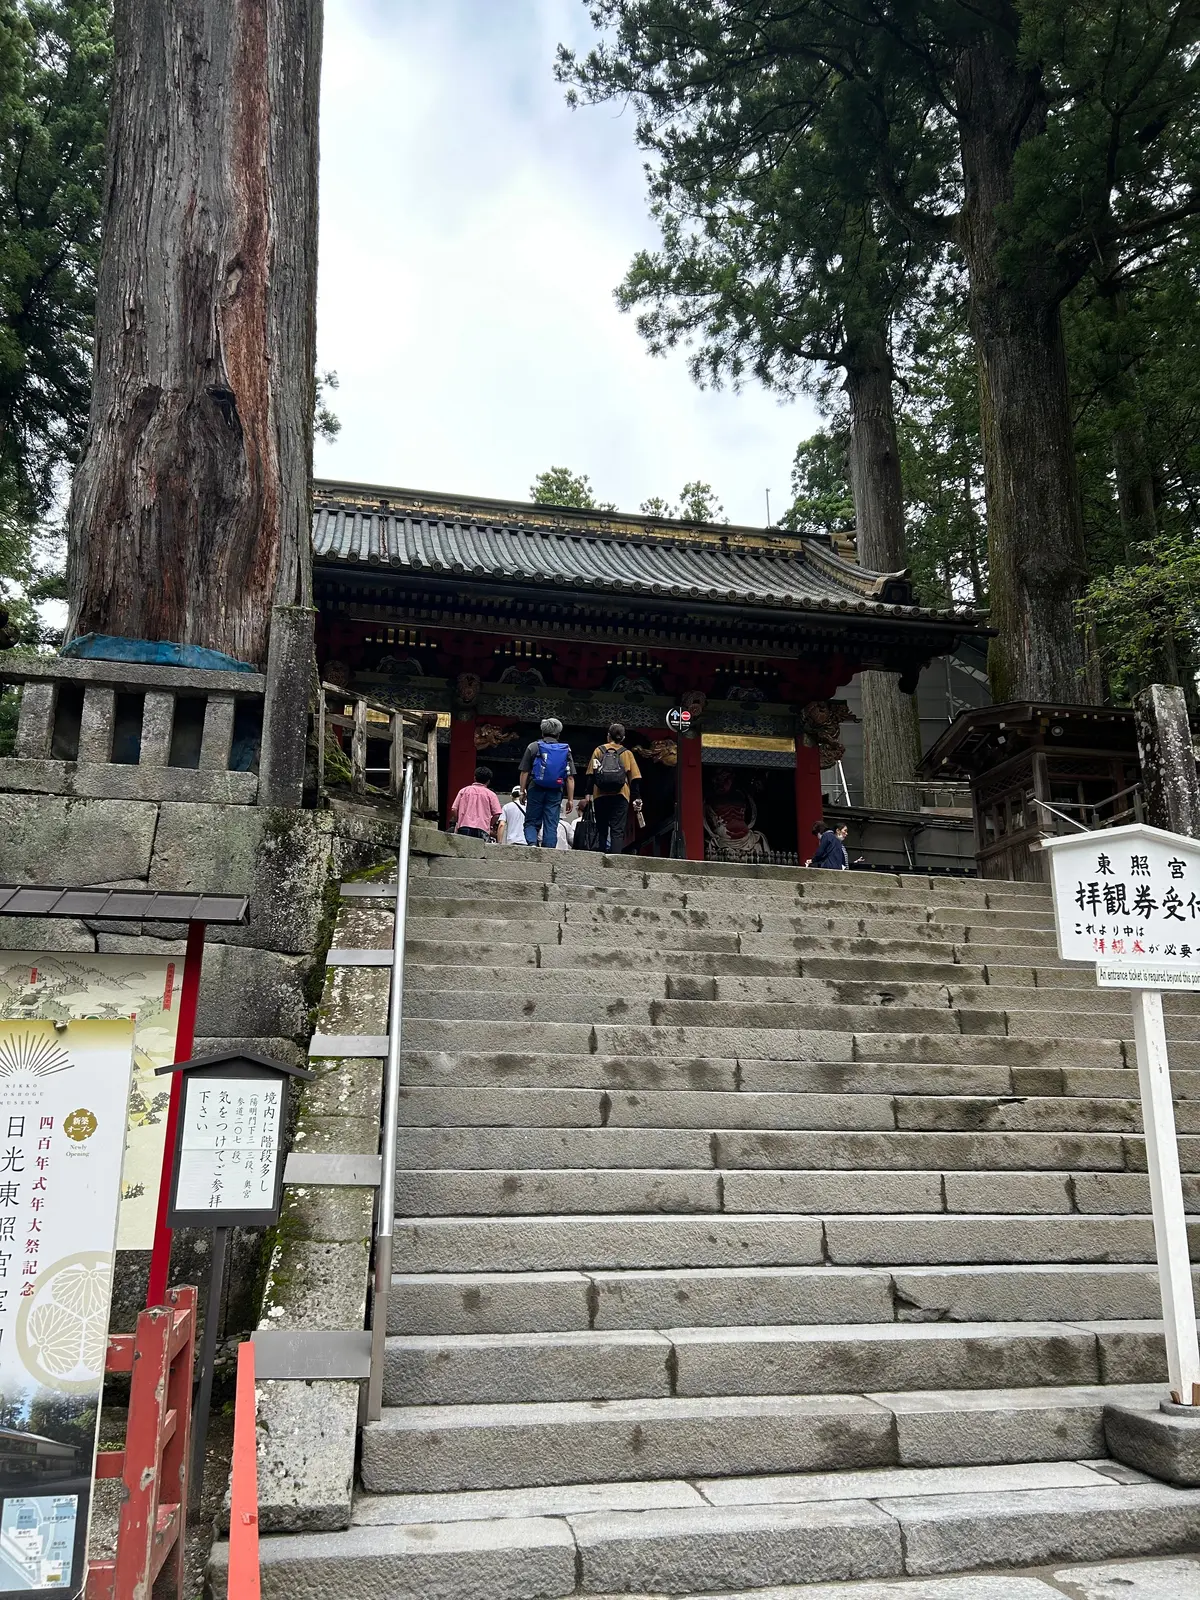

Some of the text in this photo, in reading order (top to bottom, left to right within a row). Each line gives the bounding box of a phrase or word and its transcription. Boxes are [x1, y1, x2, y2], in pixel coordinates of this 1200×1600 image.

[1095, 853, 1187, 879] 東照宮
[1075, 923, 1145, 937] これより中は
[1093, 938, 1200, 958] 拝観券が必要
[1100, 968, 1106, 980] An
[1107, 969, 1128, 980] entrance
[1128, 968, 1142, 981] ticket
[1142, 969, 1148, 981] is
[1148, 969, 1166, 983] required
[1166, 969, 1181, 984] beyond
[1182, 970, 1191, 983] this
[73, 1116, 90, 1125] 新築
[196, 1090, 211, 1131] 下さい
[209, 1090, 231, 1208] 気をつけてご参拝
[260, 1091, 277, 1192] 境内に階段多し
[19, 1116, 54, 1297] 四百年式年大祭記念
